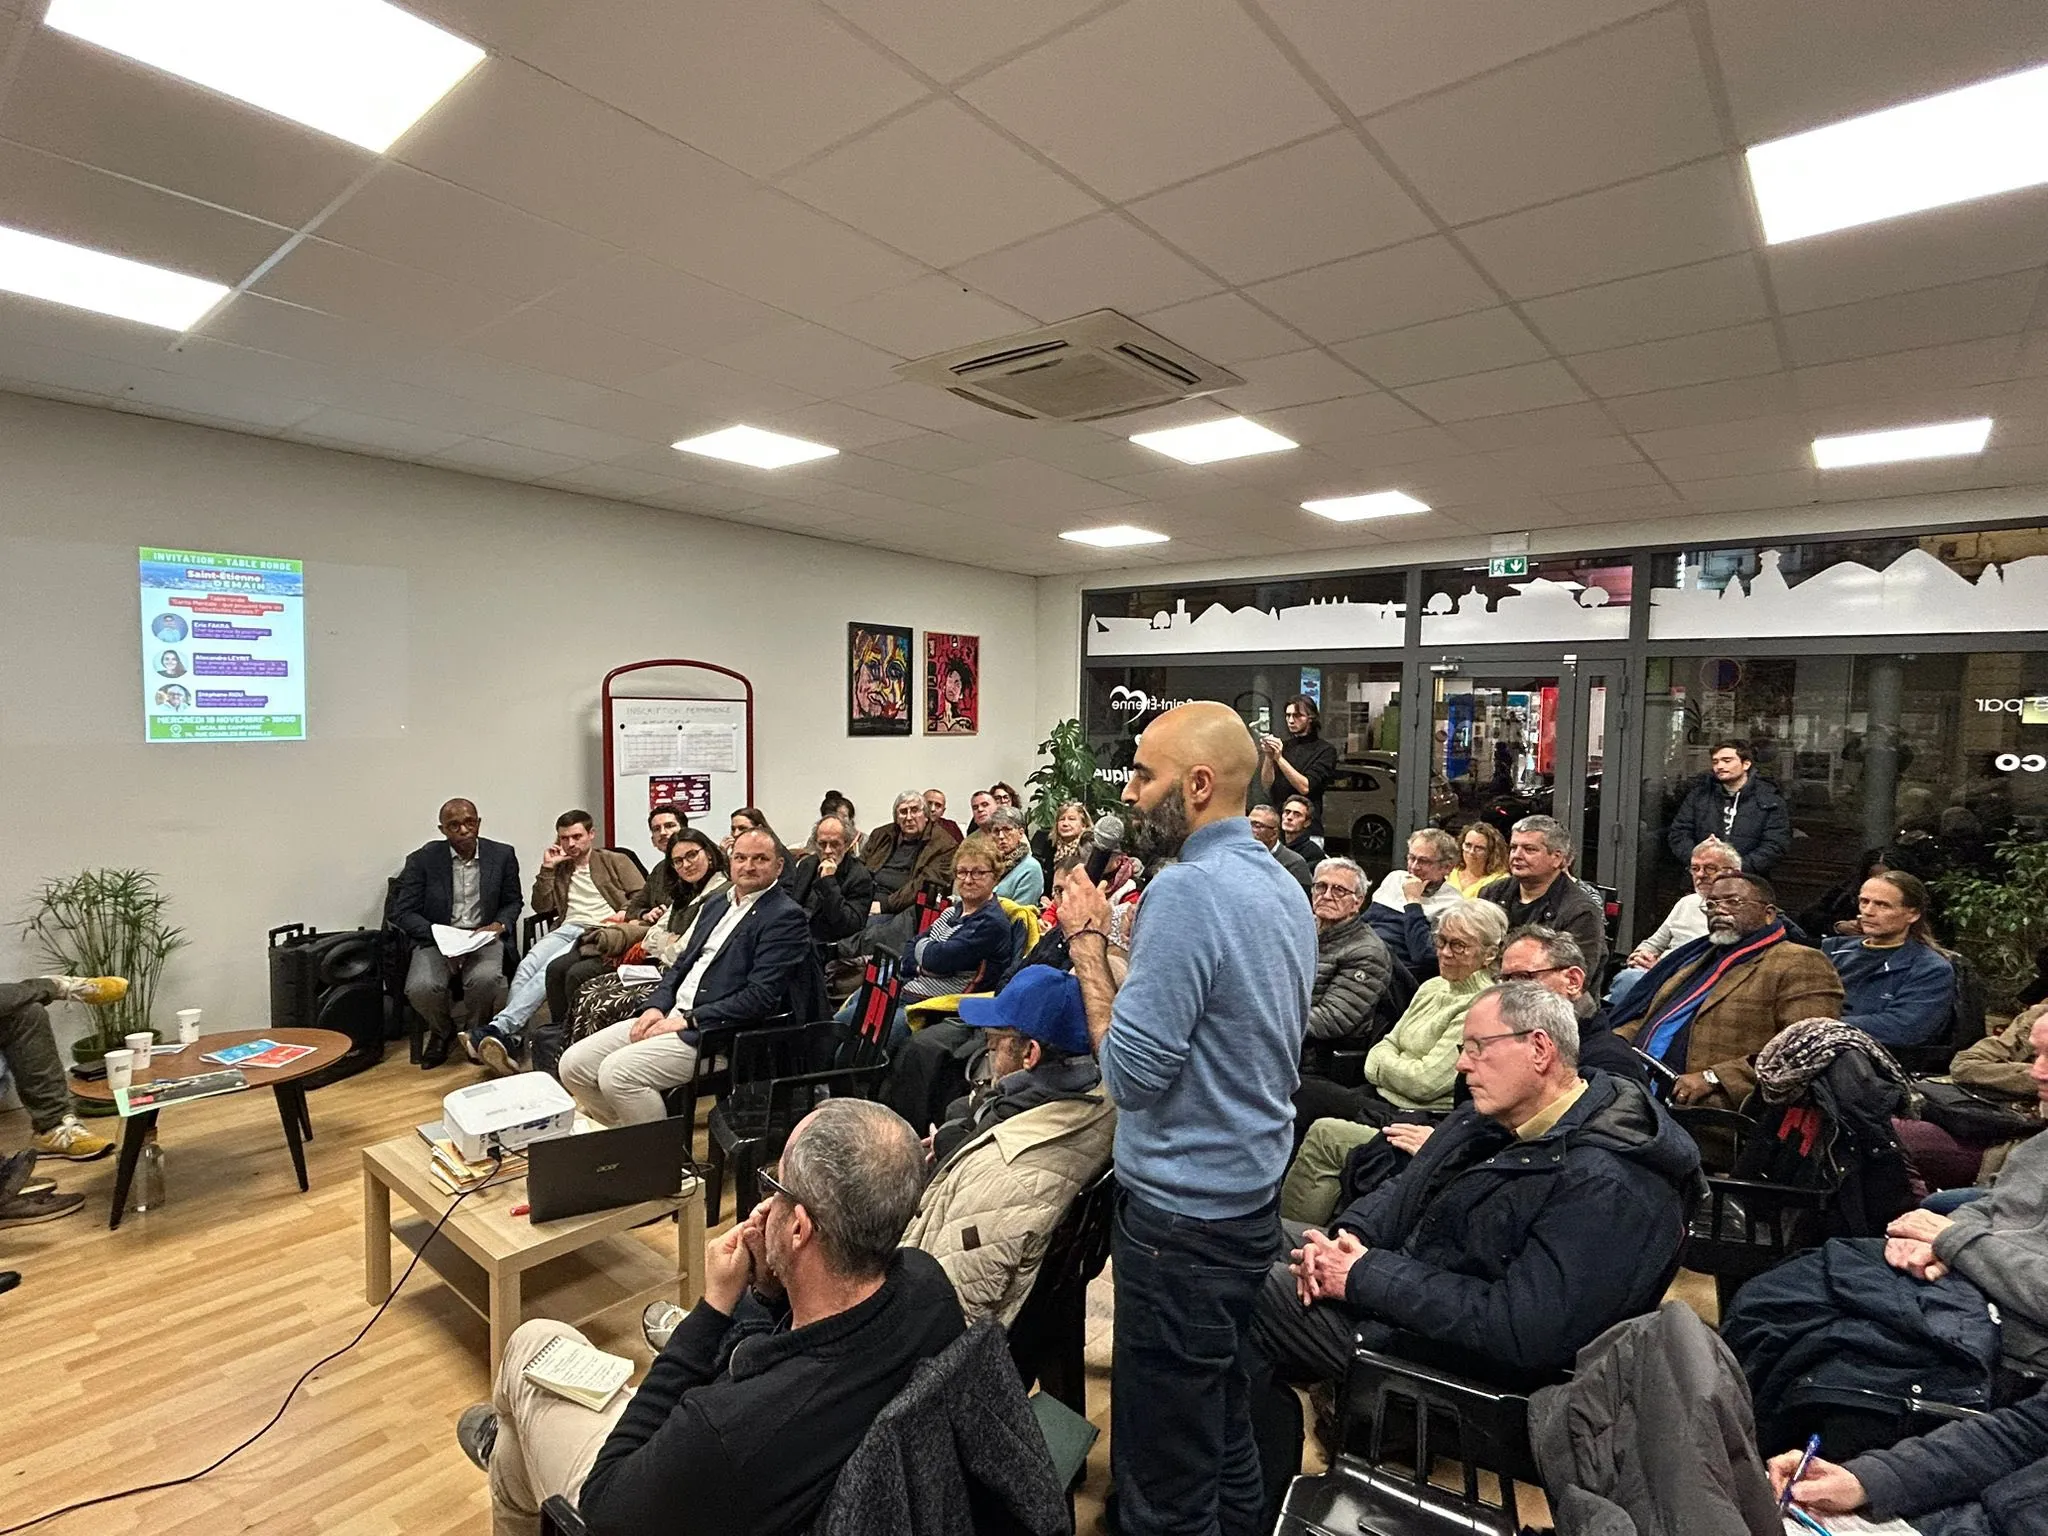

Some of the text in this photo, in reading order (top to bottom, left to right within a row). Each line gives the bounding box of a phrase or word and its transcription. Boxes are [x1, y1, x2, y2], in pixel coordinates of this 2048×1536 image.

[153, 552, 214, 565] INVITATION
[226, 558, 257, 569] TABLE
[259, 561, 292, 571] RONDE
[212, 581, 266, 591] DEMAIN
[596, 1162, 620, 1173] acer
